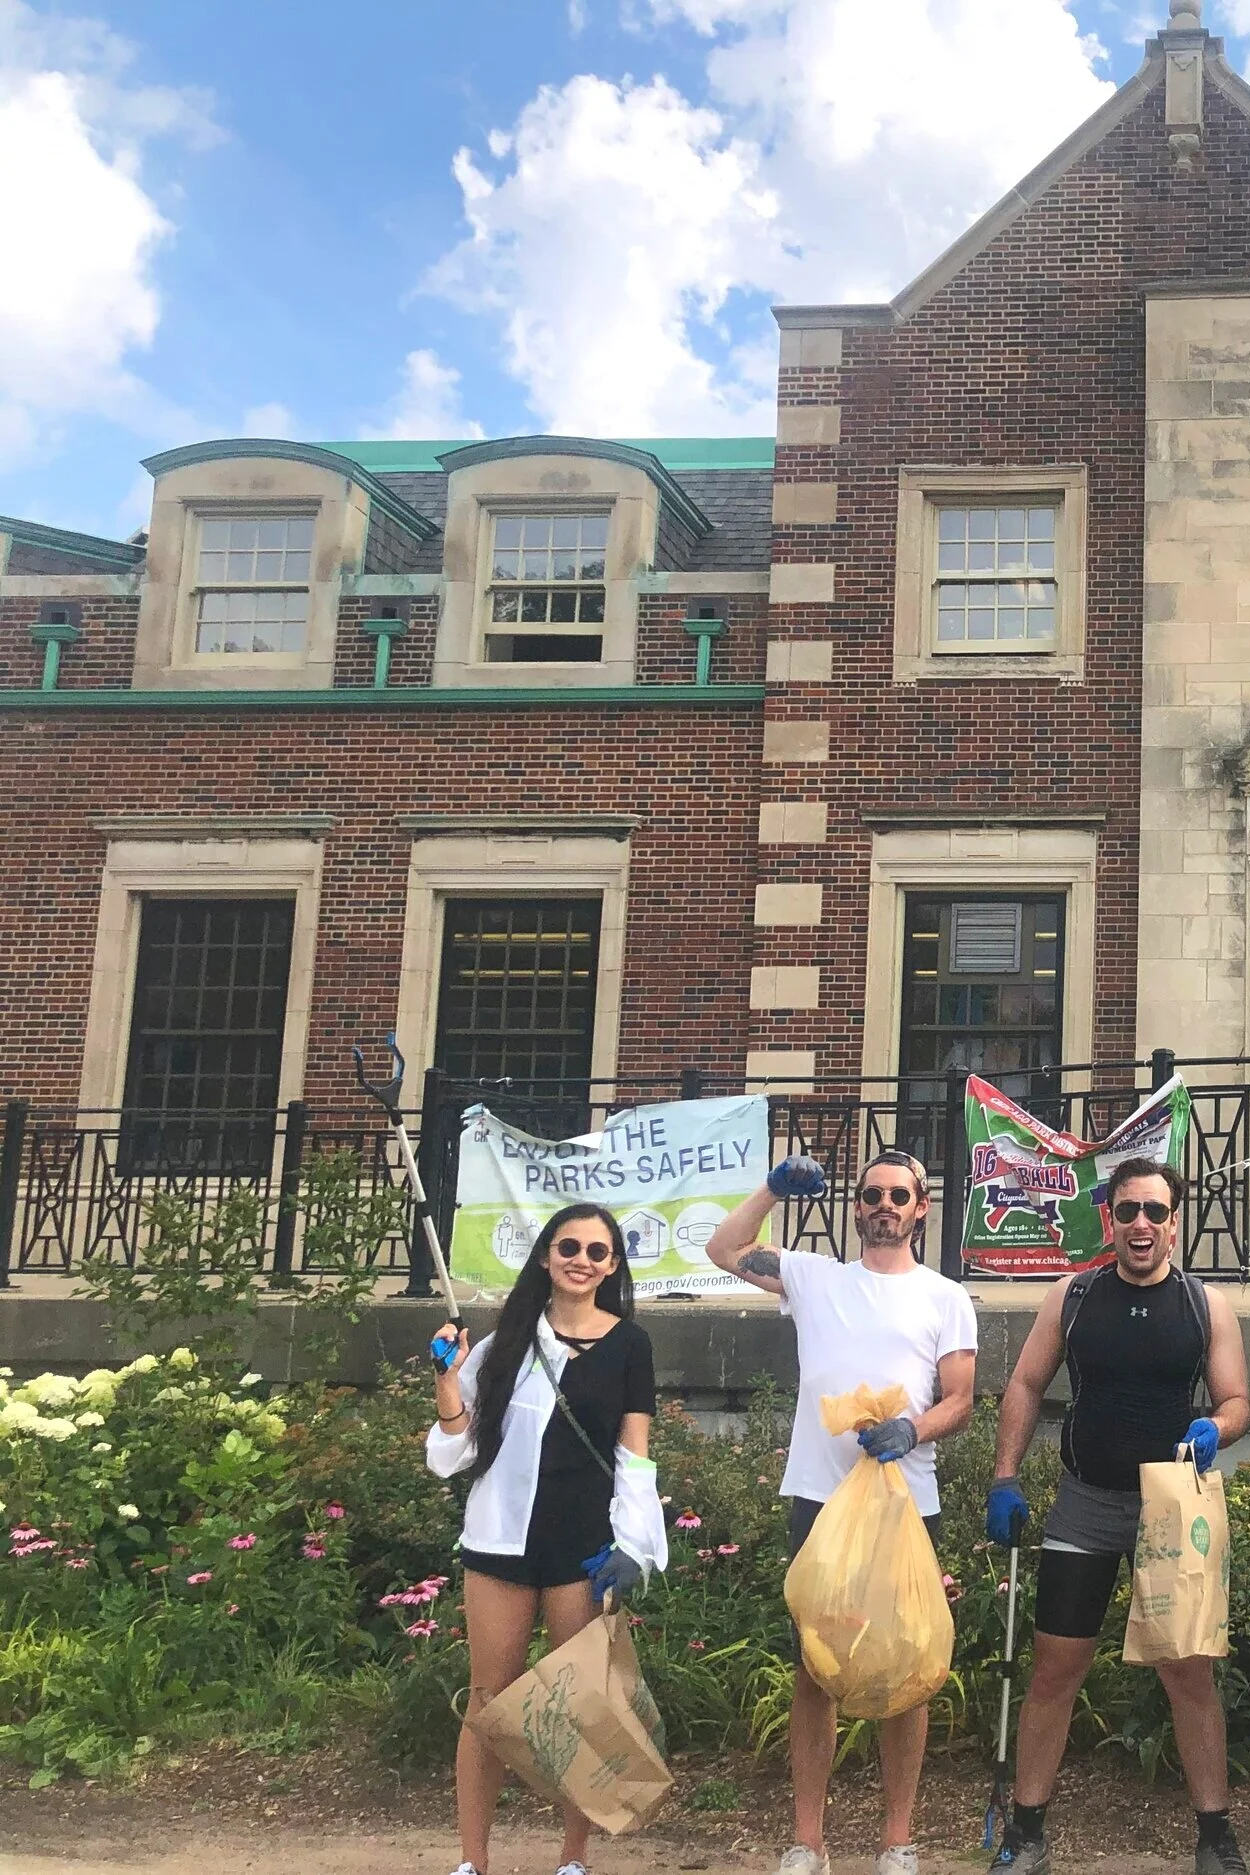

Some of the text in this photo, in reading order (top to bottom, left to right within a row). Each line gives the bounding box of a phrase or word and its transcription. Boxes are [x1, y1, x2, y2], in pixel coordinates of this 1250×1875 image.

[604, 1118, 667, 1153] THE
[525, 1138, 752, 1192] PARKS SAFELY
[975, 1149, 997, 1181] 16
[1013, 1257, 1021, 1265] at
